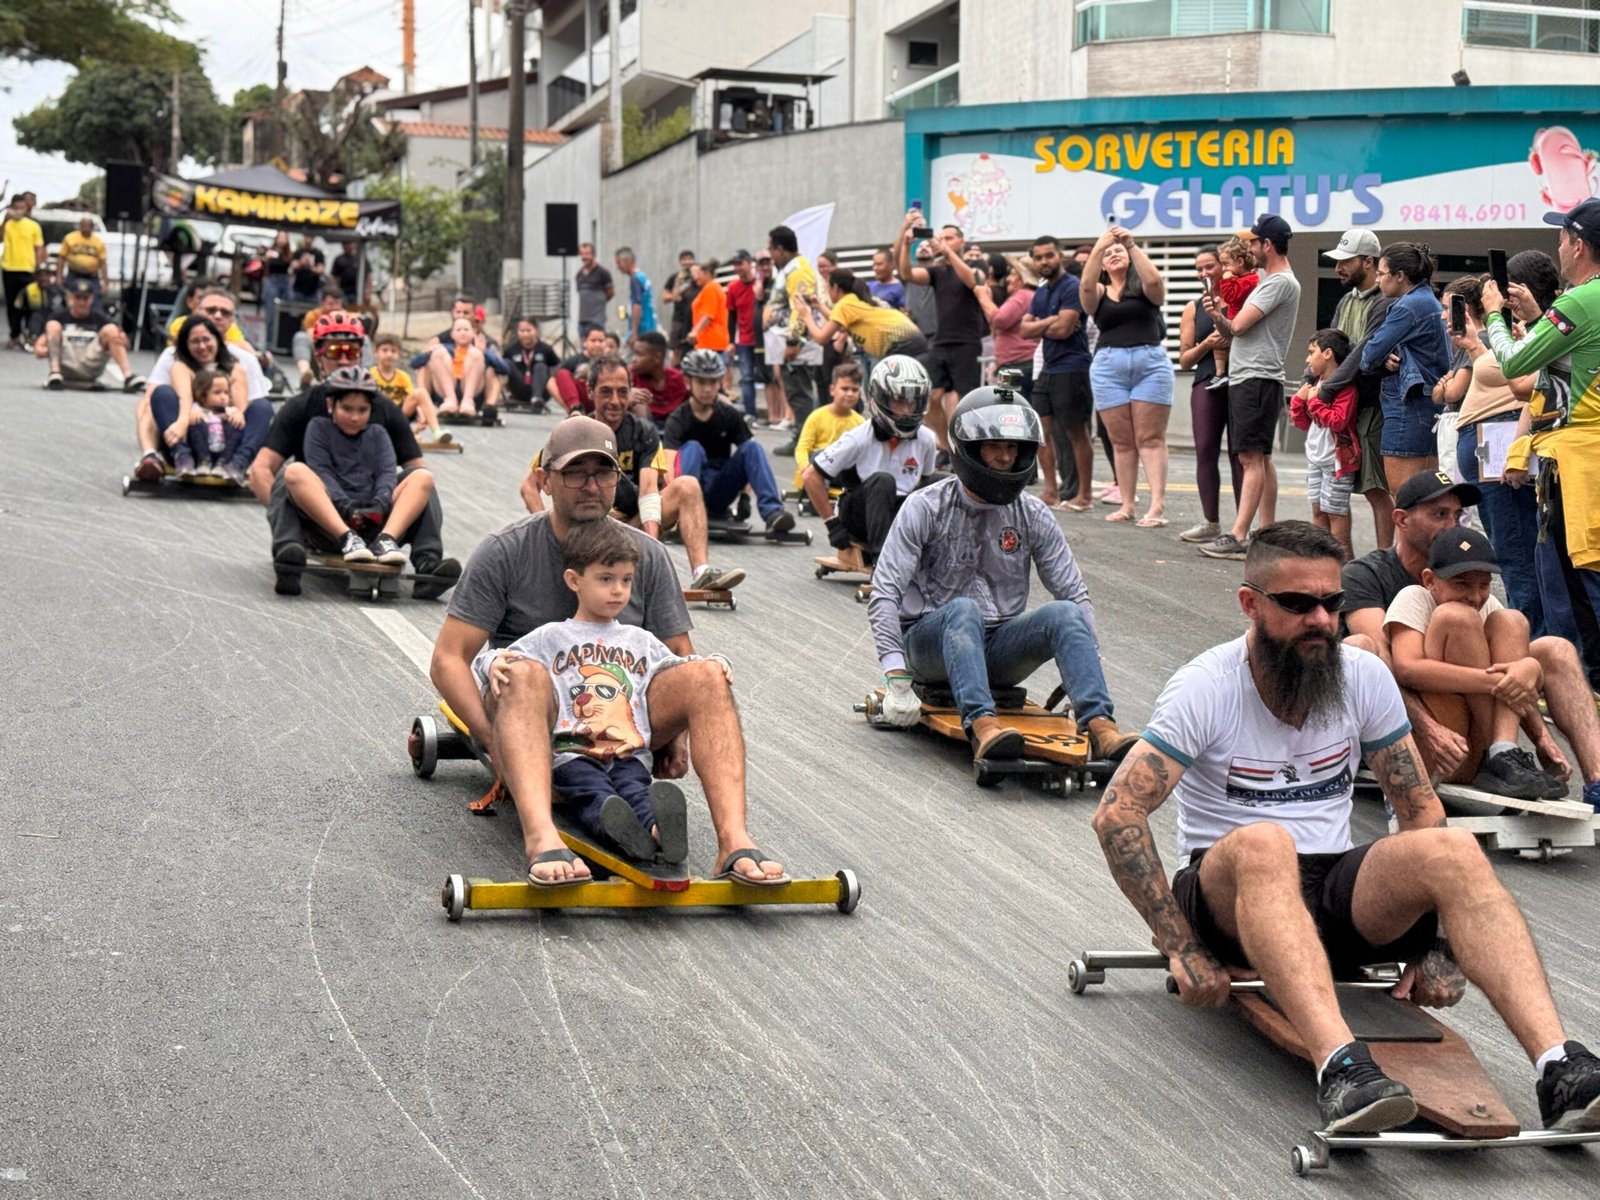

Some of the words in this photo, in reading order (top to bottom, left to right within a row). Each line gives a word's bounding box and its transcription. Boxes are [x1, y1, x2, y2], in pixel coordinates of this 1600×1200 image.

[1034, 128, 1294, 173] SORVETERIA
[195, 185, 360, 227] KAMIKAZE
[1101, 173, 1384, 230] GELATU'S
[1400, 203, 1527, 222] 98414.6901
[552, 642, 648, 677] CAPIVARA
